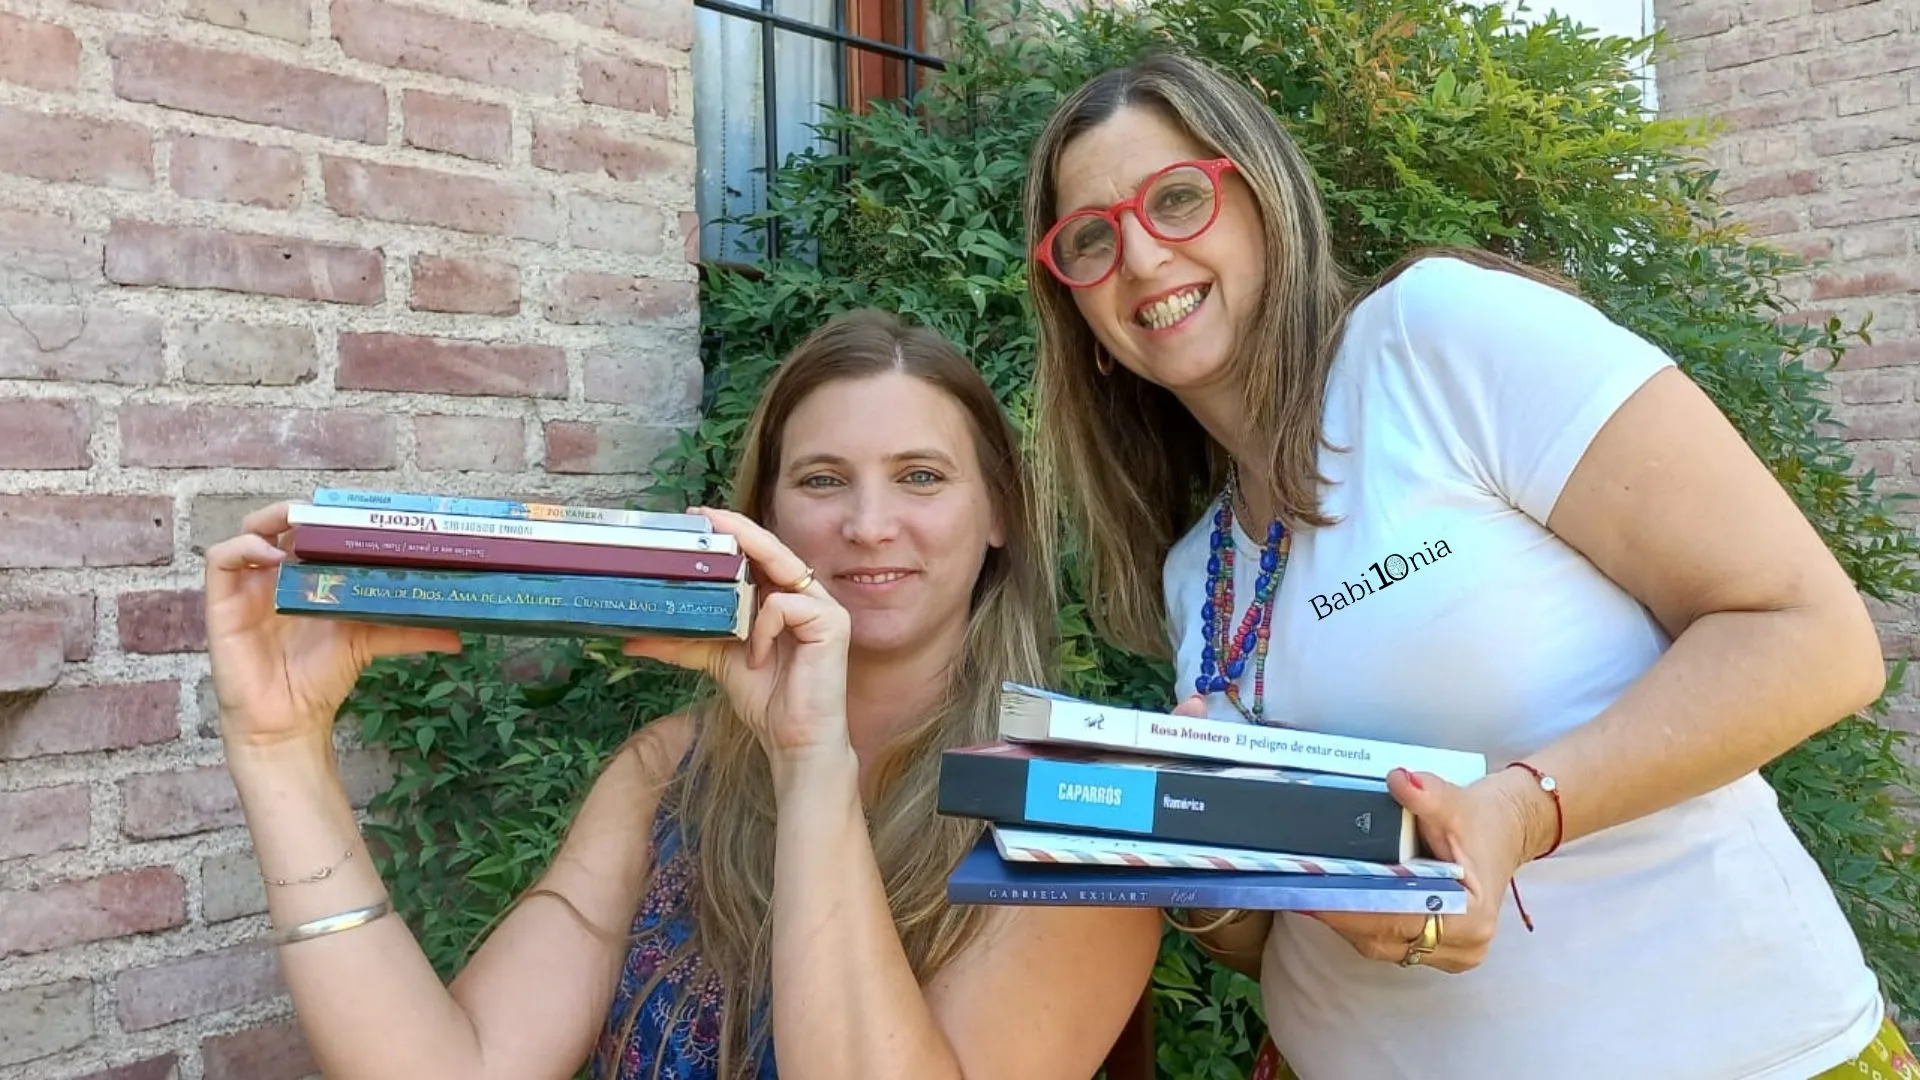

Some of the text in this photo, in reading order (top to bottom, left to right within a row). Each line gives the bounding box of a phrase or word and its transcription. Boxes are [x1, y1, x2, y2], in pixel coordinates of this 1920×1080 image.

[370, 513, 438, 531] Victoria
[449, 589, 478, 602] AMA
[515, 593, 562, 606] MUERTE
[573, 595, 625, 610] CRISTINA
[1150, 722, 1371, 761] Rosa Montero El peligro de estar cuerda
[1058, 782, 1123, 806] CAPARRÓS
[989, 888, 1149, 901] GABRIELA EXILART
